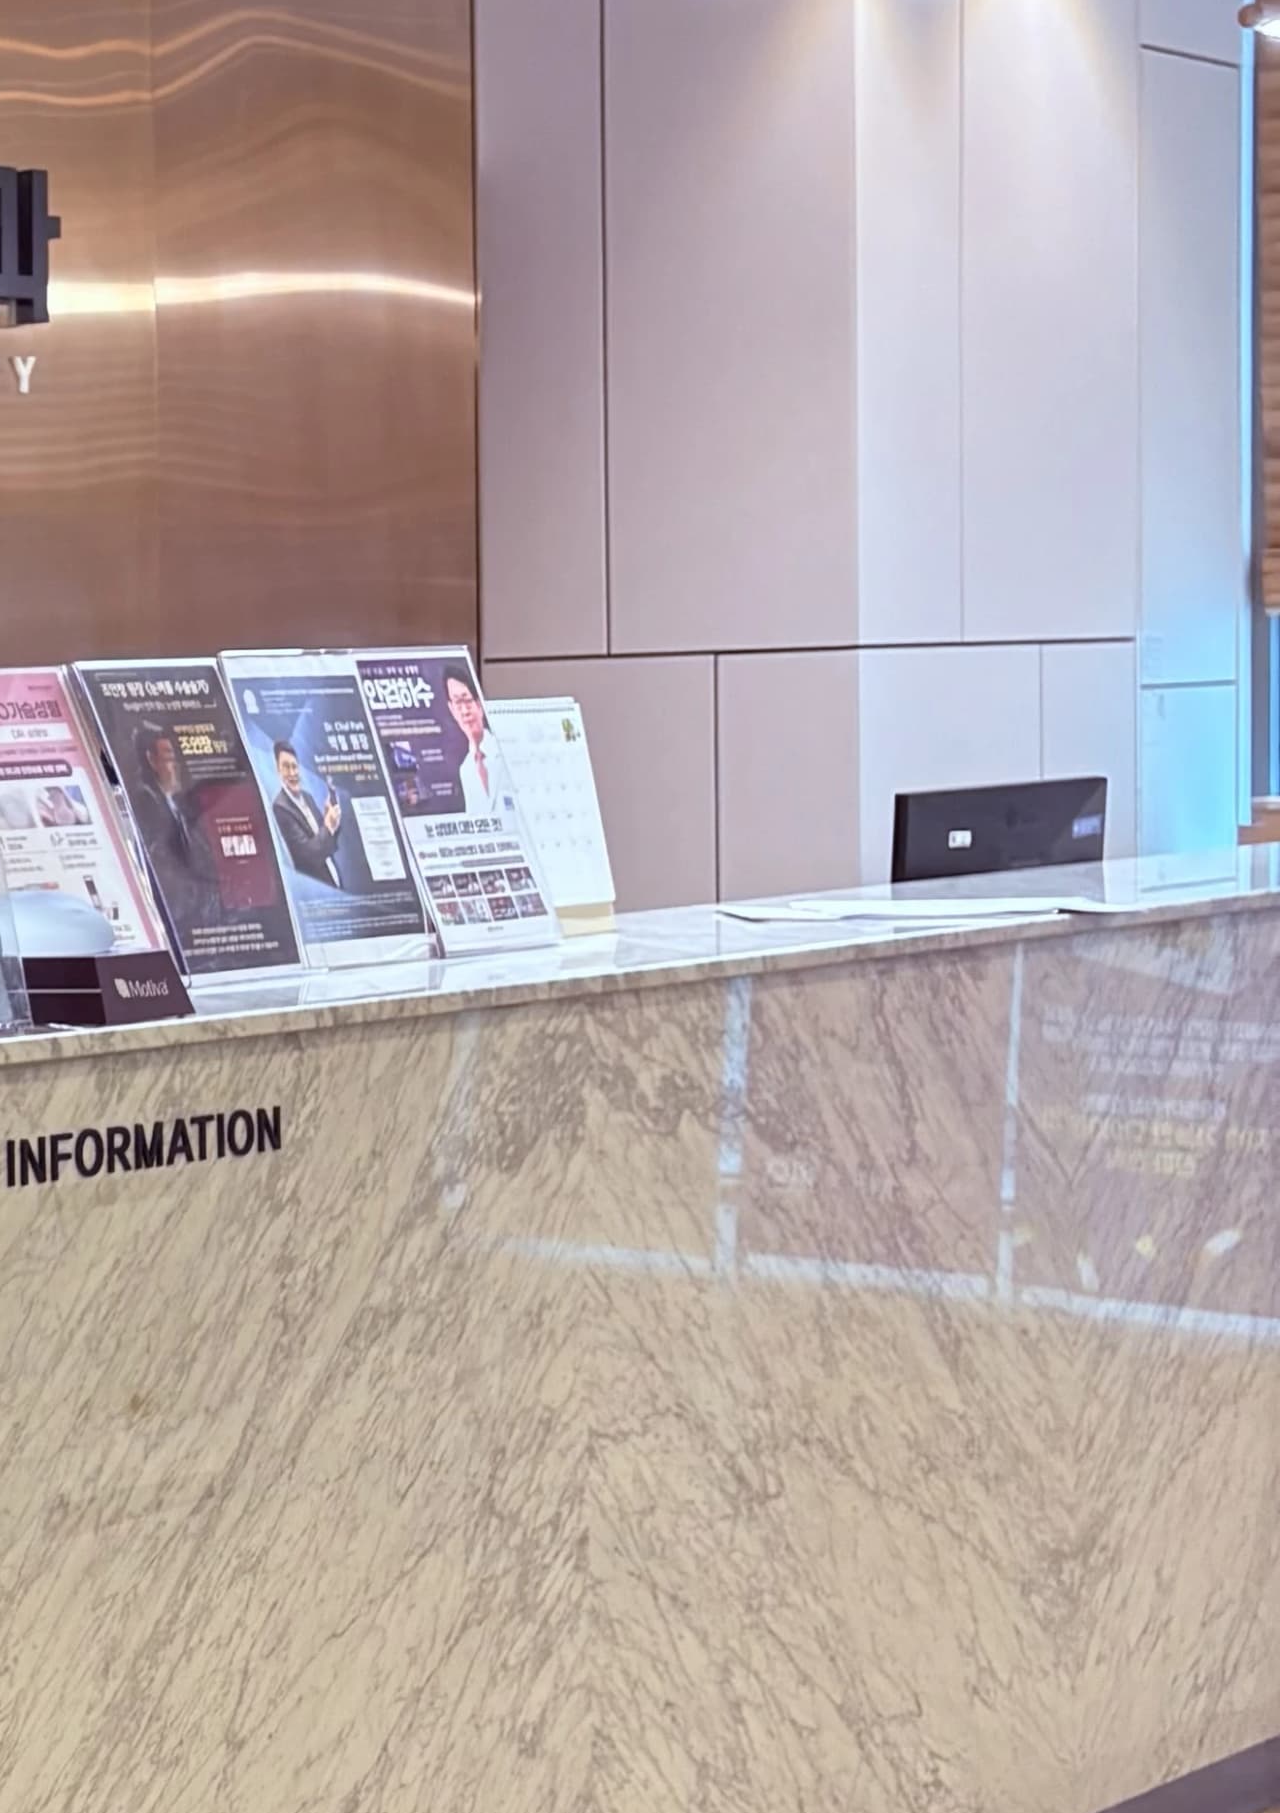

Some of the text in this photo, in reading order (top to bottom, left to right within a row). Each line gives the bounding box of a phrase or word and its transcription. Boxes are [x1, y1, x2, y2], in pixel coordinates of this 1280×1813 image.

[363, 677, 434, 710] 안검하수
[128, 978, 170, 999] Motiva
[6, 1105, 282, 1188] INFORMATION
